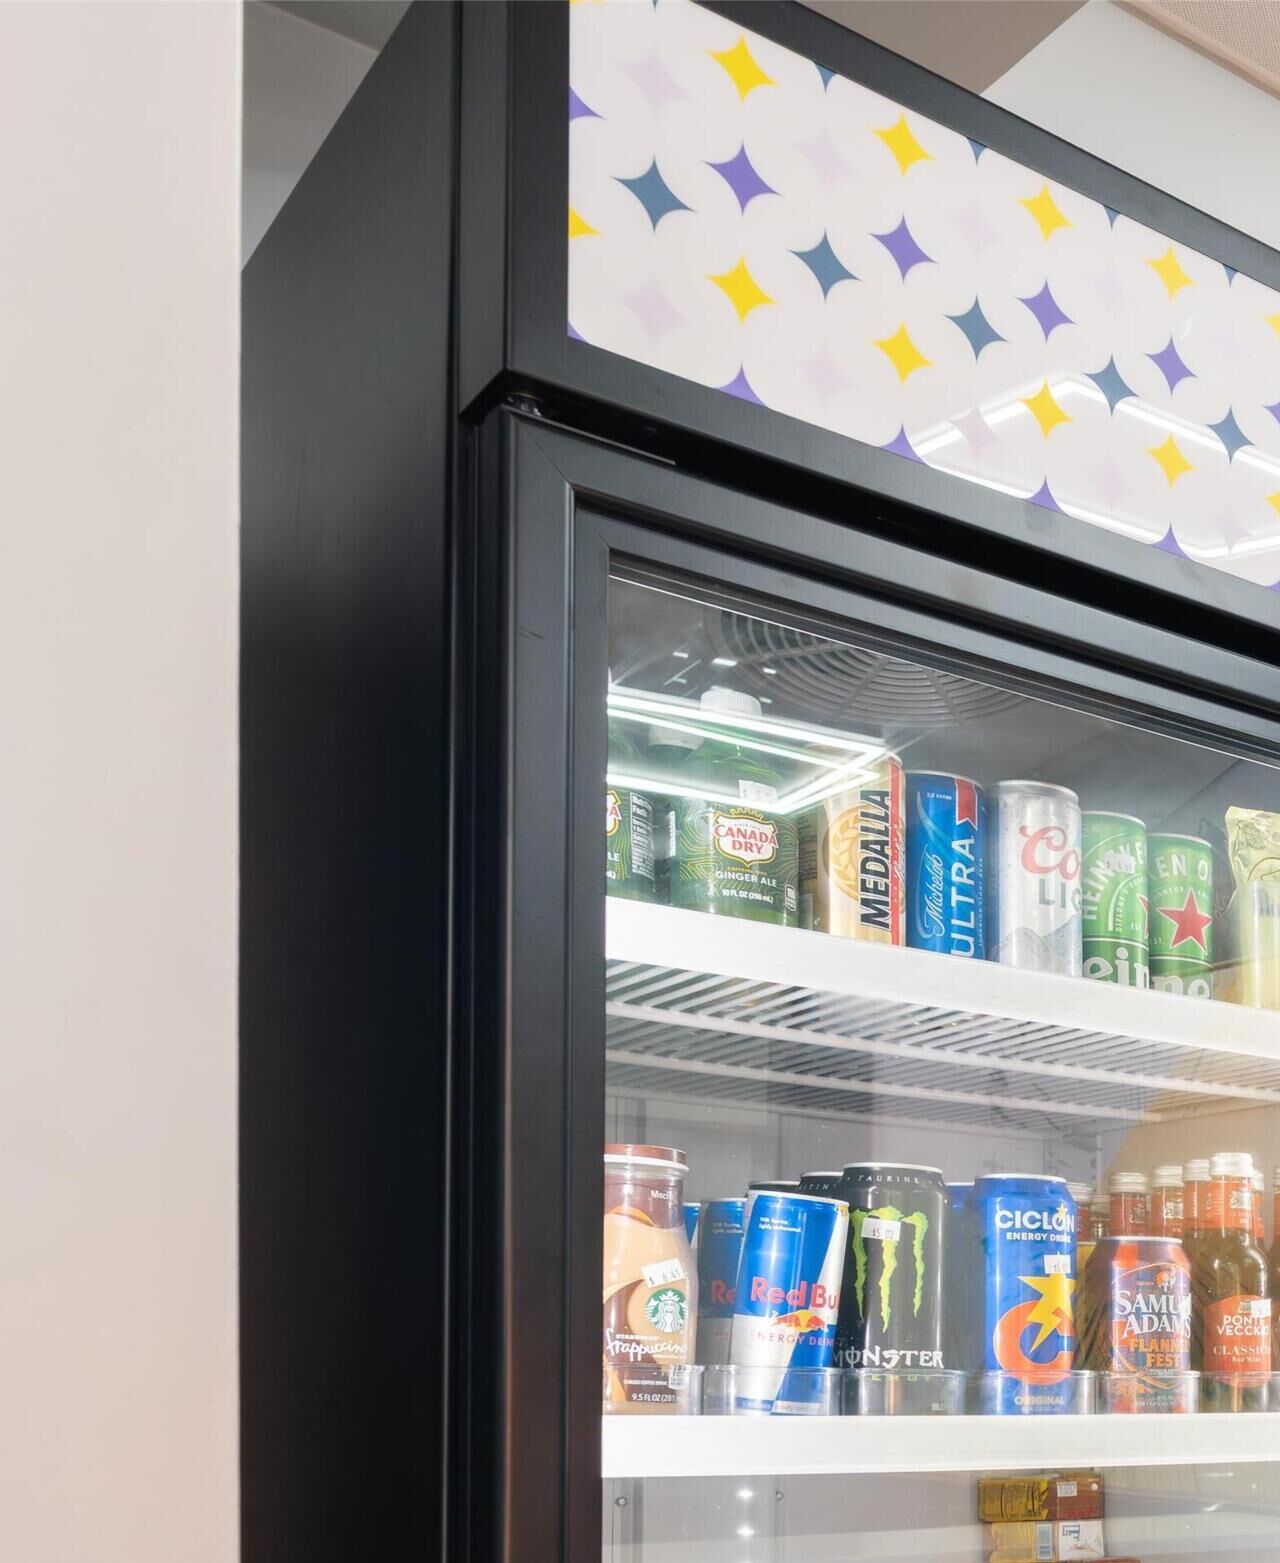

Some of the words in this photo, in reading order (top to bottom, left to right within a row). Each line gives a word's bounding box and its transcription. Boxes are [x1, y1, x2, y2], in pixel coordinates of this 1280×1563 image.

[714, 824, 779, 849] CANADA
[732, 839, 765, 855] DRY
[859, 790, 891, 931] MEDALLA
[715, 870, 758, 883] GINGER
[760, 875, 777, 888] ALE
[923, 850, 945, 937] Michelob
[950, 836, 975, 957] ULTRA
[857, 1174, 921, 1184] TAURINE
[1006, 1231, 1048, 1242] ENERGY
[1050, 1233, 1071, 1243] DRINK
[750, 1276, 808, 1306] Red
[1122, 1313, 1191, 1340] ADAMS
[1147, 1354, 1182, 1368] FEST
[632, 1393, 644, 1401] 9.5
[652, 1394, 660, 1402] OZ
[1014, 1394, 1065, 1406] ORIGINAL
